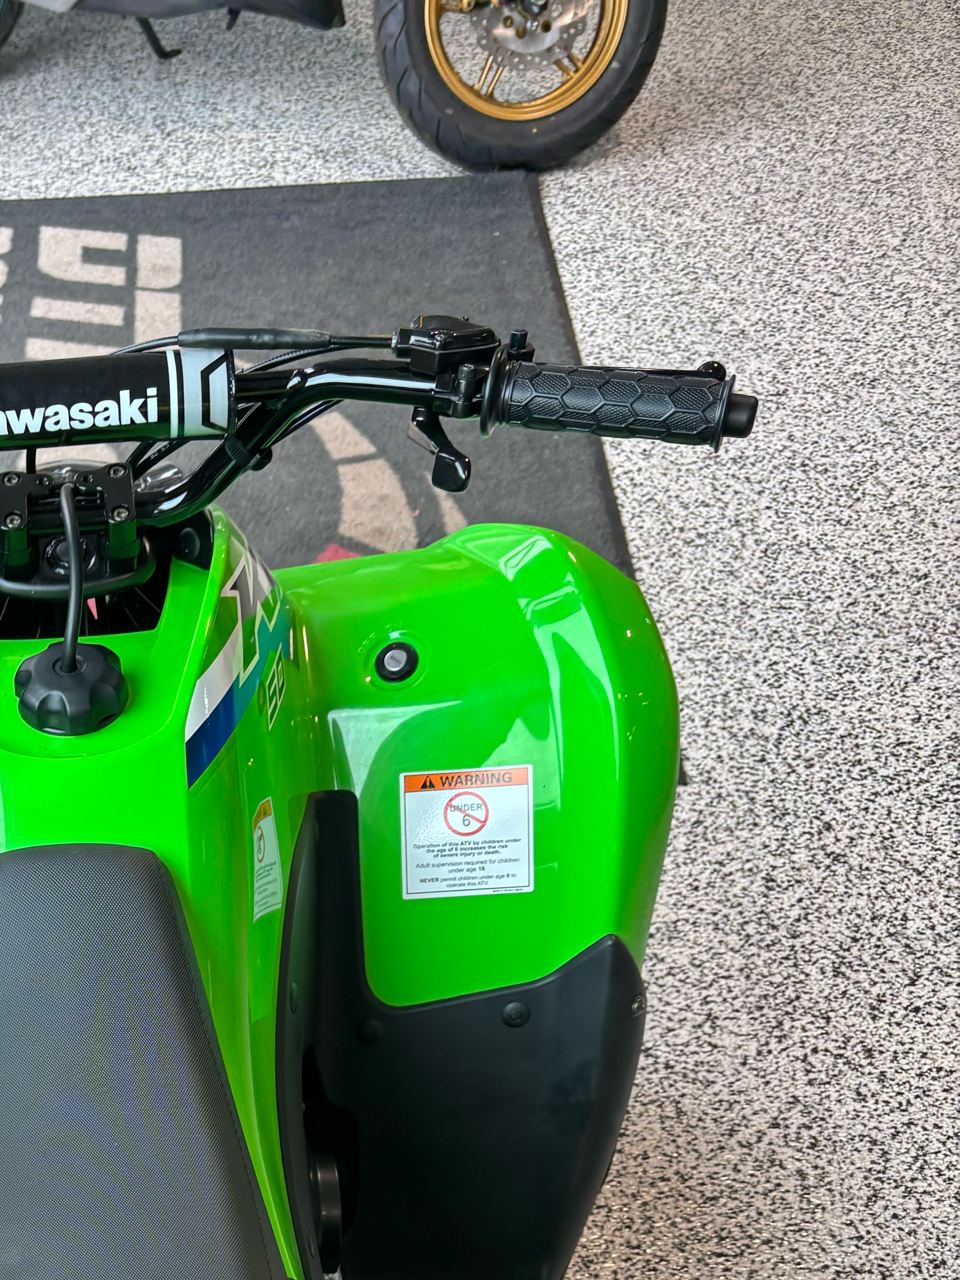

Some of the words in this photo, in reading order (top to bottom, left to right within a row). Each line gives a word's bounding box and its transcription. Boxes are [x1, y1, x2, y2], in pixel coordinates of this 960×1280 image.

[439, 771, 512, 787] WARNING
[449, 802, 483, 812] UNDER
[461, 814, 470, 827] 6
